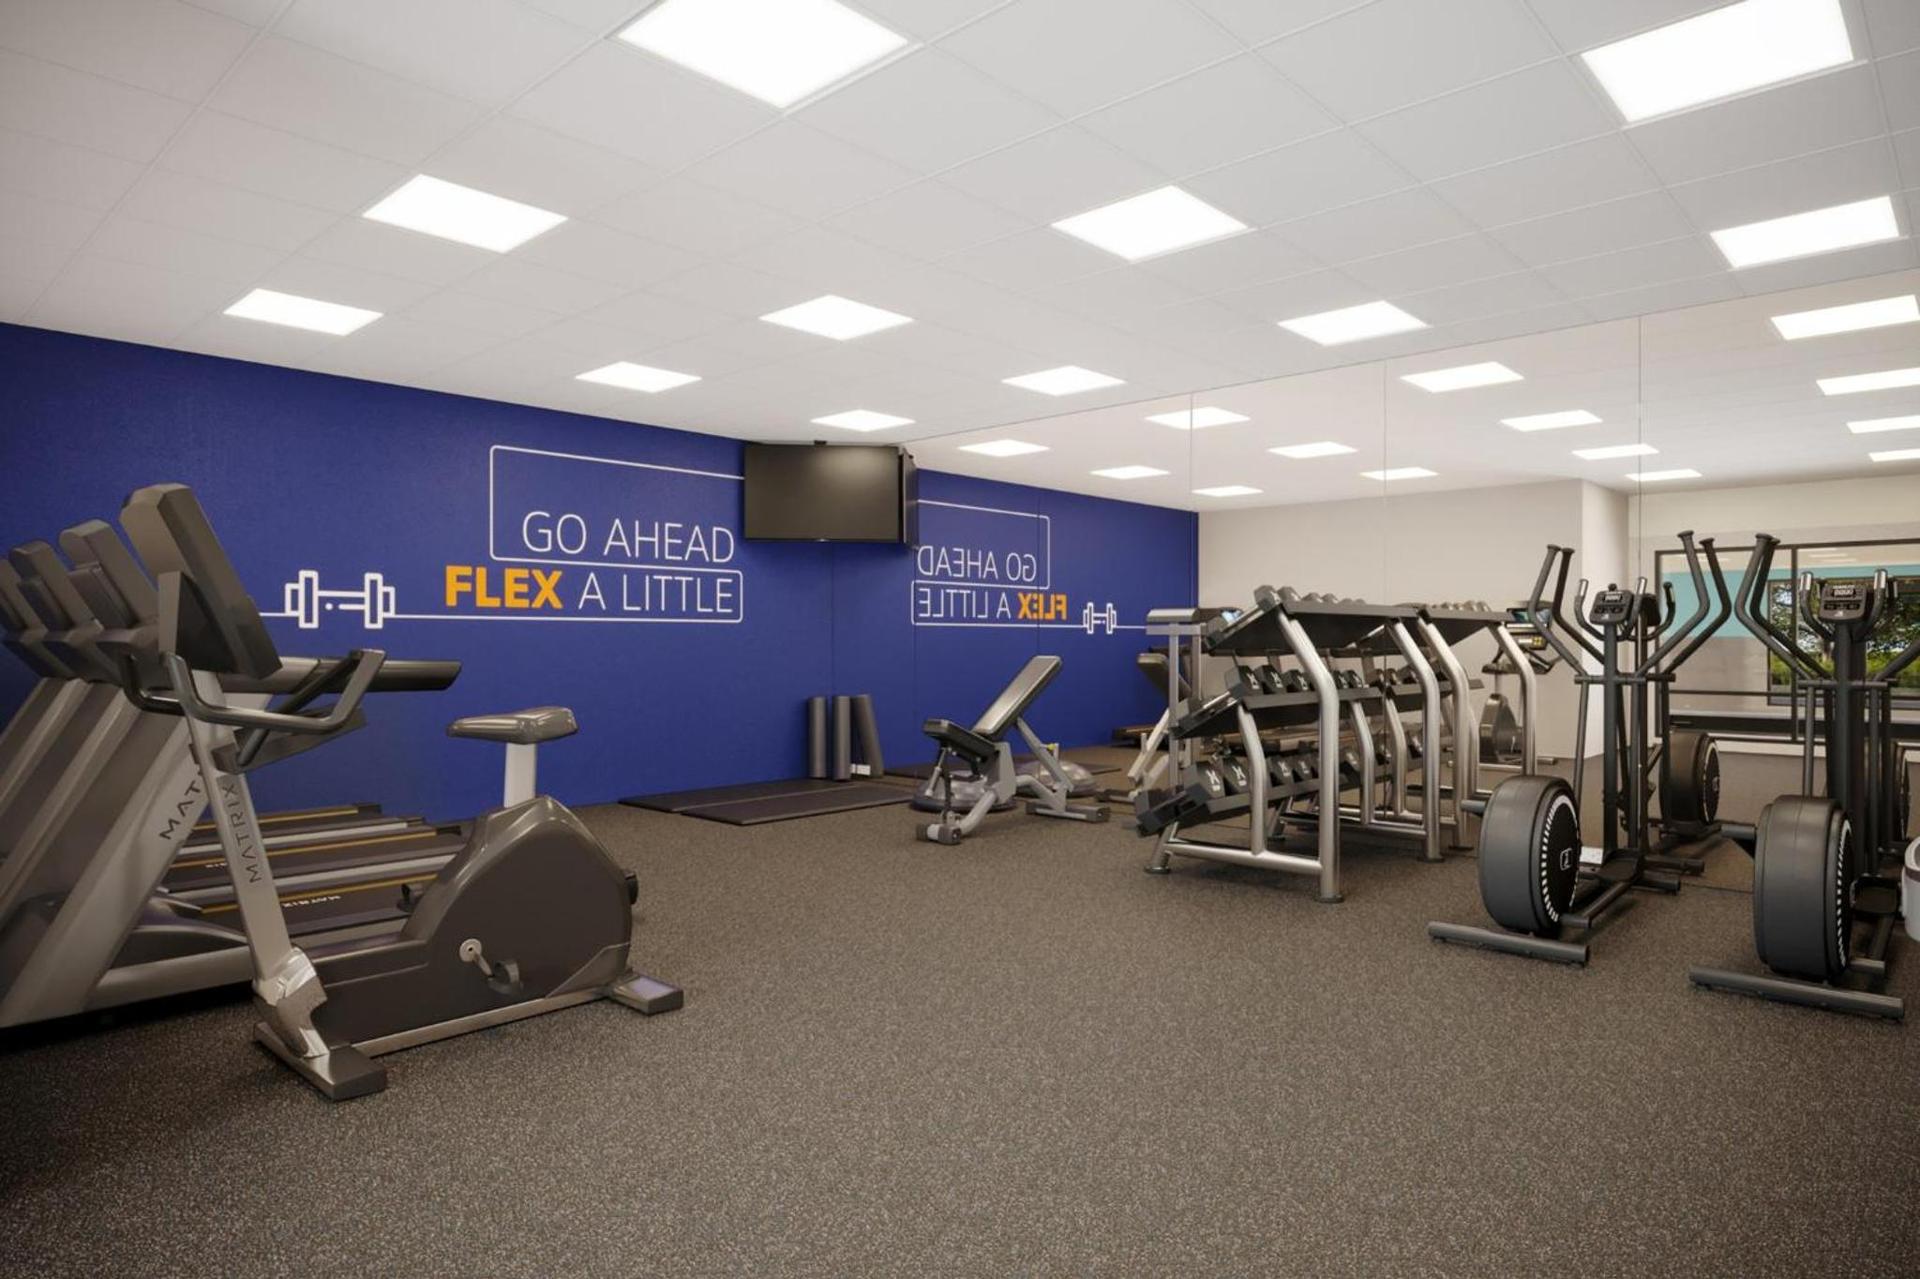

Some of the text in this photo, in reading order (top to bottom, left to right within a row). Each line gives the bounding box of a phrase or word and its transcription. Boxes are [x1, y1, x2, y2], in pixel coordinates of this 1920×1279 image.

[522, 511, 734, 563] GO AHEAD
[445, 565, 733, 613] FLEX A LITTLE
[159, 770, 203, 840] MAT
[222, 783, 262, 883] MATRIX
